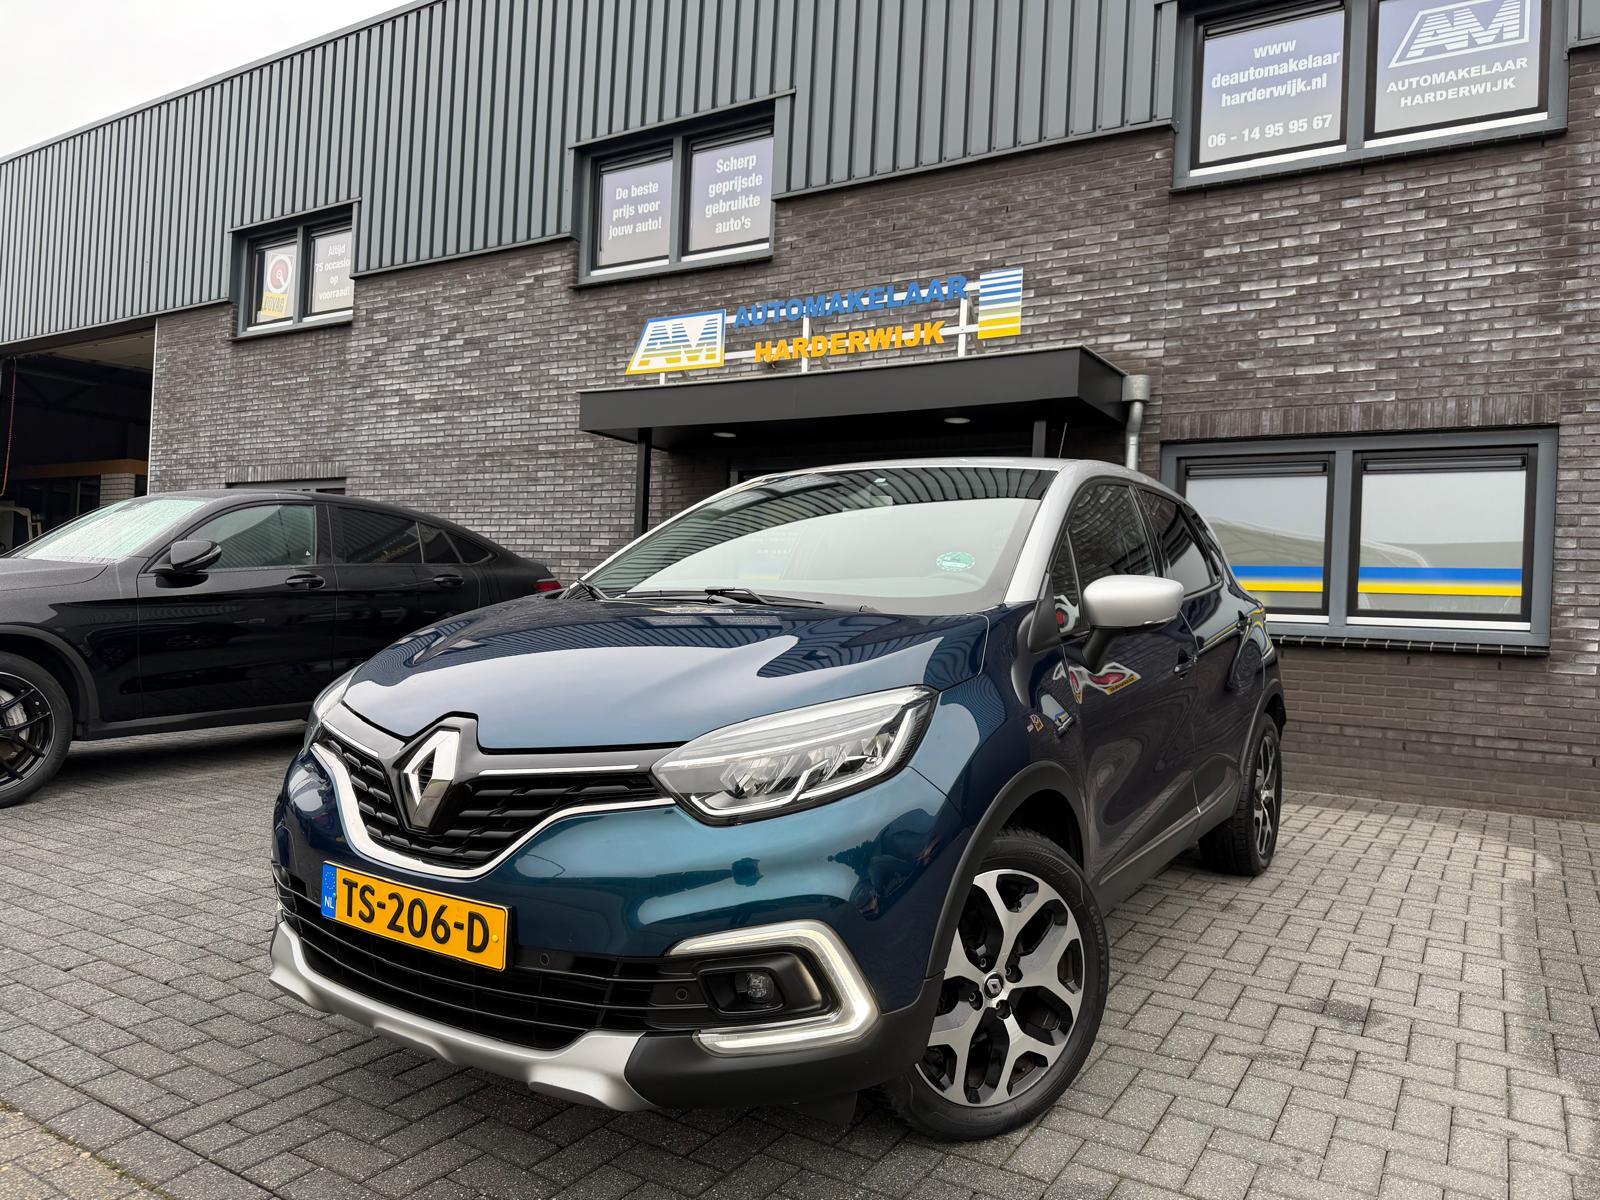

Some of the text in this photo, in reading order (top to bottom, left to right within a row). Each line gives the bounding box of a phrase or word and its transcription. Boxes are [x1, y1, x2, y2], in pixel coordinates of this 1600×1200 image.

[1406, 0, 1520, 58] AM
[1253, 40, 1297, 59] www
[1211, 51, 1341, 88] deautomakelaar
[1386, 57, 1528, 93] AUTOMAKELAAR
[1221, 73, 1327, 107] harderwijk.nl
[1400, 77, 1516, 107] HARDERWIJK
[1207, 133, 1226, 148] 06
[1242, 128, 1260, 142] 14
[1264, 122, 1284, 138] 95
[1288, 118, 1308, 134] 95
[1312, 114, 1333, 129] 67
[716, 155, 757, 174] Scherp
[615, 181, 659, 200] De beste
[708, 174, 763, 198] geprijsde
[612, 200, 661, 222] prijs voor
[705, 194, 761, 218] gebruikte
[608, 216, 662, 240] jouw auto!
[715, 215, 752, 234] auto's
[328, 243, 346, 257] Altijd
[315, 257, 350, 274] 75 occasio
[329, 275, 338, 286] op
[733, 275, 968, 329] AUTOMAKELAAR
[637, 320, 717, 367] AM
[754, 320, 945, 363] HARDERWIJK
[324, 896, 334, 909] NL
[342, 877, 490, 953] TS-206-D
